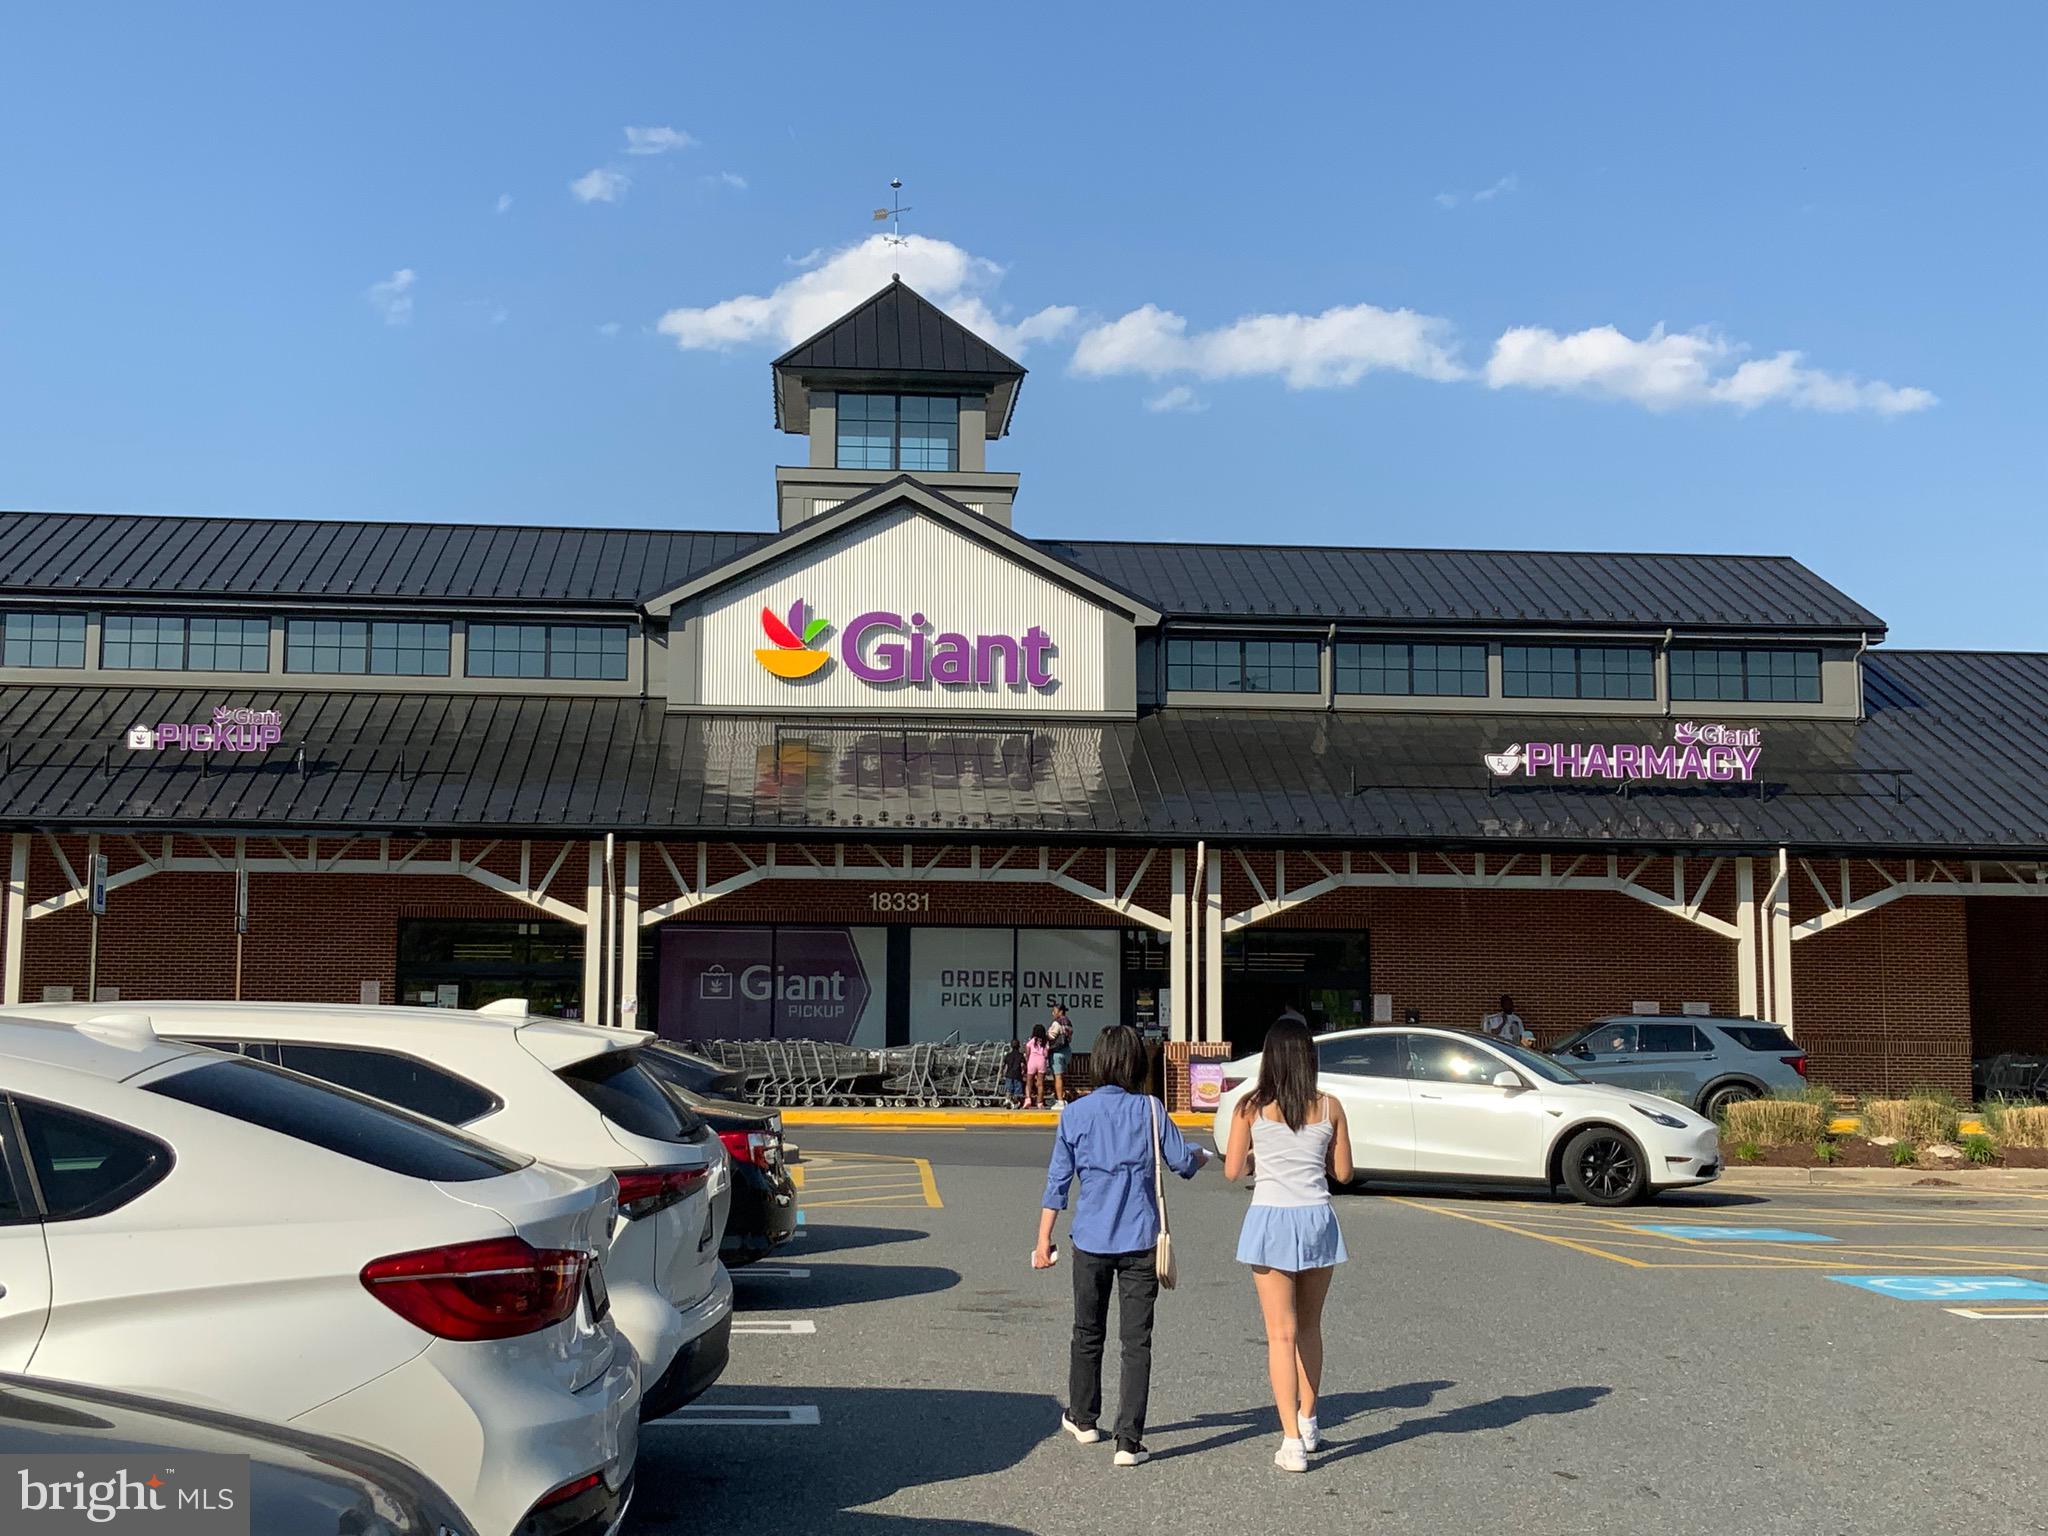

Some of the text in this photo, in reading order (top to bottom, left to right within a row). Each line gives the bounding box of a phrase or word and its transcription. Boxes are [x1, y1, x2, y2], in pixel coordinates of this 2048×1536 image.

[841, 611, 1053, 687] Giant
[234, 707, 282, 725] Giant
[157, 723, 281, 752] PICKUP
[1700, 724, 1761, 746] Giant
[1525, 742, 1762, 781] PHARMACY
[869, 892, 929, 911] 18331
[740, 964, 846, 1001] Giant
[941, 970, 1104, 989] ORDER ONLINE
[941, 992, 1104, 1009] PICK UP AT STORE
[788, 1004, 845, 1018] PICKUP
